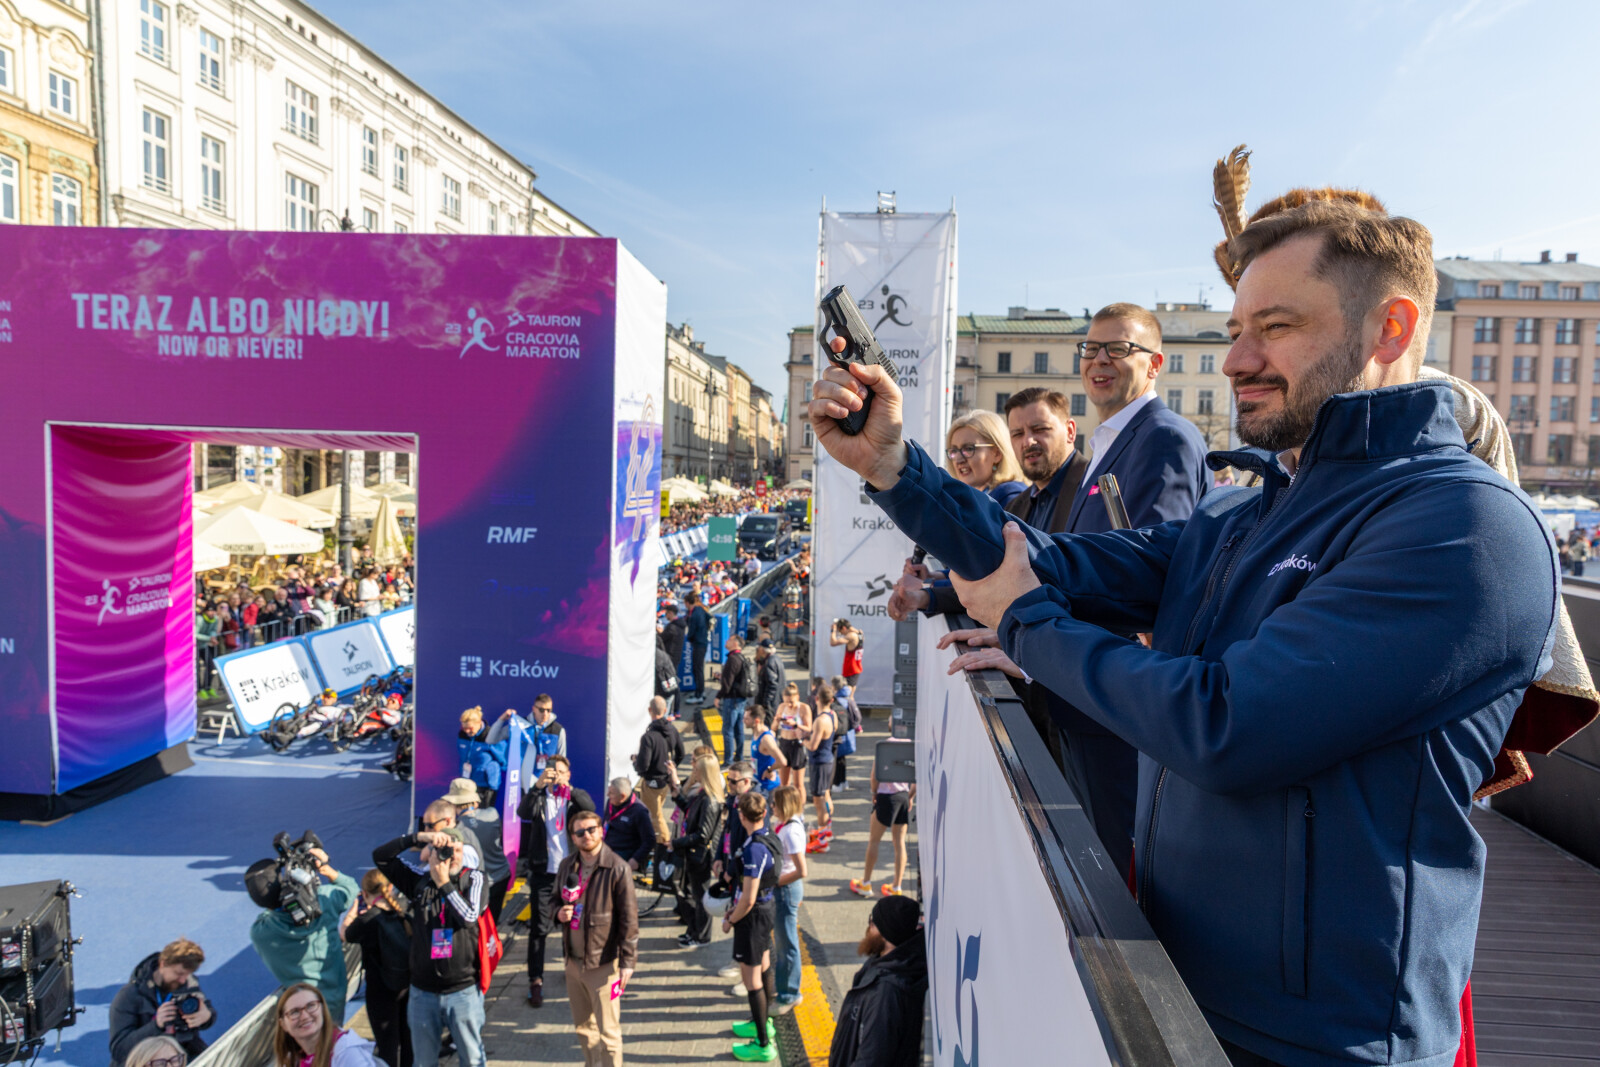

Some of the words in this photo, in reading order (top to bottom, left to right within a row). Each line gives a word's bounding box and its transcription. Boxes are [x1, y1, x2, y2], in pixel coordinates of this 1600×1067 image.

[859, 301, 874, 310] 23
[71, 293, 173, 331] TERAZ
[187, 296, 269, 334] ALBO
[284, 298, 389, 338] NIGDY!
[526, 314, 582, 327] TAURON
[445, 323, 462, 334] 23
[506, 332, 580, 346] CRACOVIA
[158, 335, 199, 357] NOW
[205, 336, 230, 358] OR
[237, 337, 303, 360] NEVER!
[506, 346, 581, 359] MARATON
[885, 349, 919, 359] URON
[487, 526, 538, 544] RMF
[141, 573, 173, 588] TAURON
[126, 597, 173, 616] MARATON
[847, 604, 887, 617] TAUR
[342, 660, 374, 677] TAURON
[489, 660, 560, 679] Kraków
